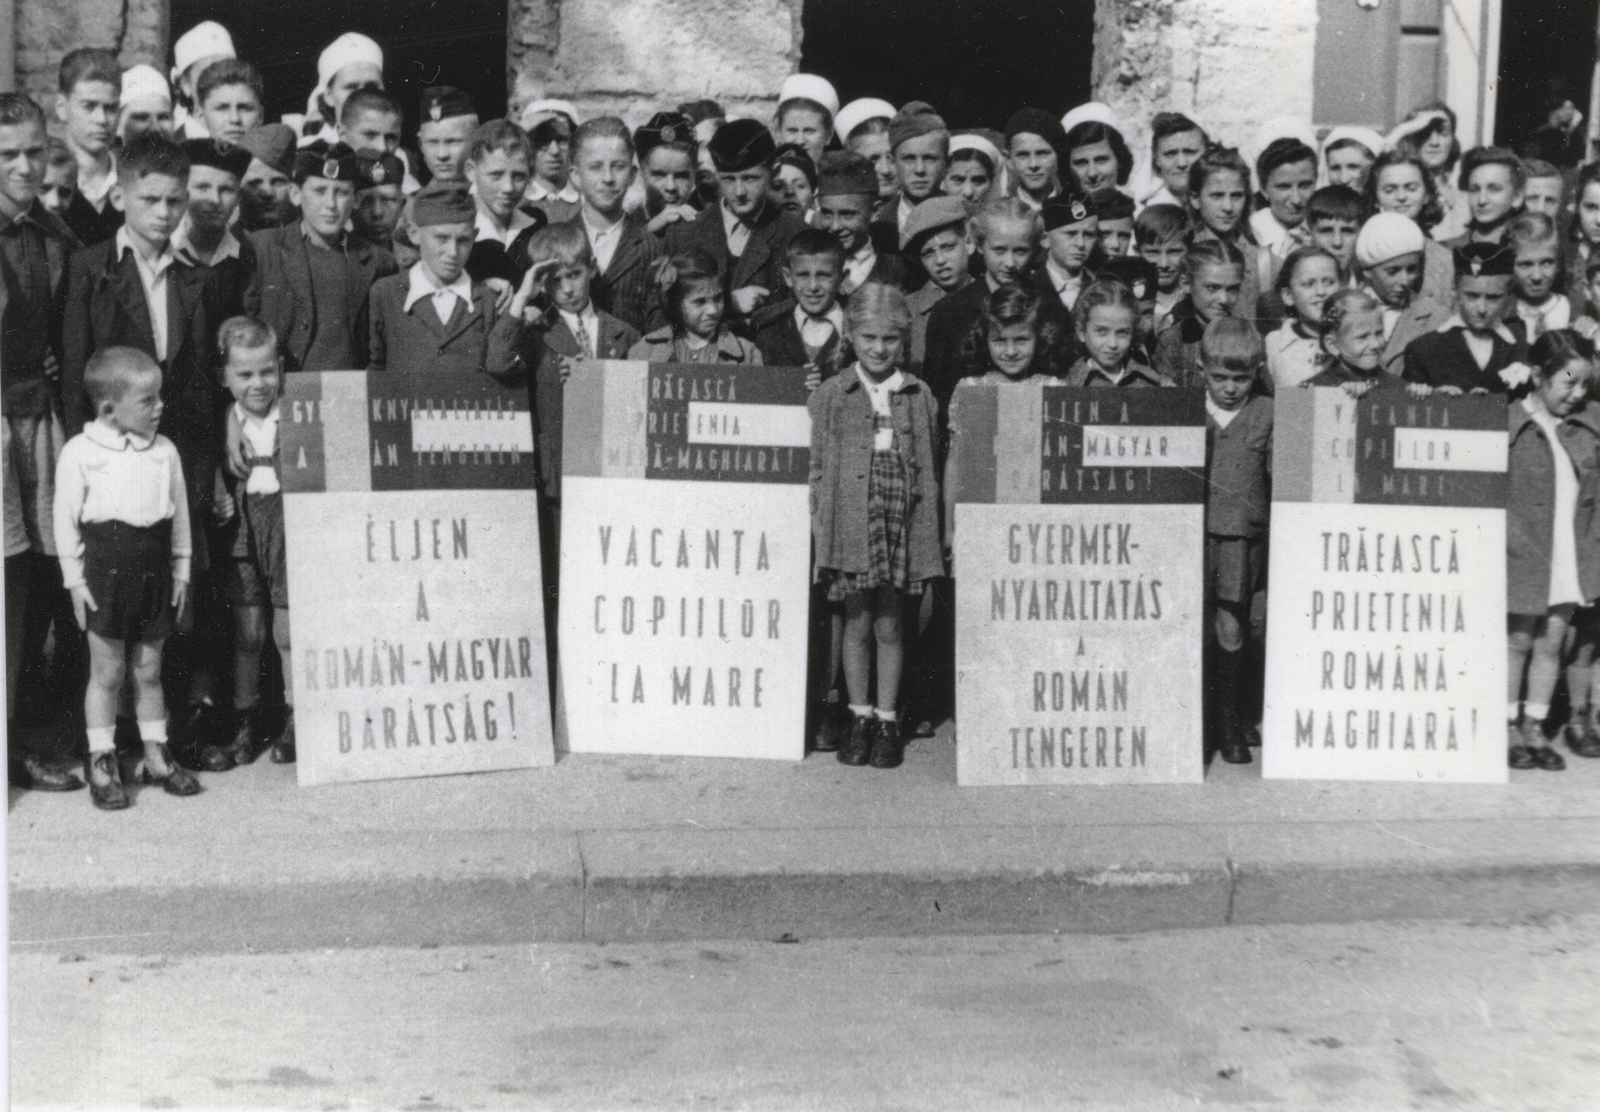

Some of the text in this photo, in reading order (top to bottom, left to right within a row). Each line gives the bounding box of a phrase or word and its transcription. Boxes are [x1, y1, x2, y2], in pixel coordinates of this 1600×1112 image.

[644, 373, 737, 400] RĂEASCĂ
[635, 411, 740, 436] PRIEENIA
[1040, 401, 1129, 424] LJEN A
[297, 445, 307, 469] A
[366, 513, 469, 563] ÉLJEN
[599, 525, 770, 575] VACANȚA
[1008, 523, 1140, 565] GYERMEK-
[1321, 526, 1460, 574] TRĂEASCĂ
[416, 580, 430, 621] A
[594, 594, 781, 640] COPIILOR
[991, 573, 1162, 621] NYARALTATÁS
[1311, 590, 1465, 633] PRIETENIA
[304, 636, 532, 690] ROMÁN-MAGYAR
[1076, 635, 1085, 656] A
[1321, 645, 1466, 691] ROMÂNĂ-
[611, 662, 763, 708] LA MARE
[1033, 664, 1128, 712] ROMÁN
[338, 691, 517, 754] BARÁTSÁG!
[1295, 706, 1478, 751] MAGHIARĂ!
[1009, 726, 1146, 768] TENGEREN
